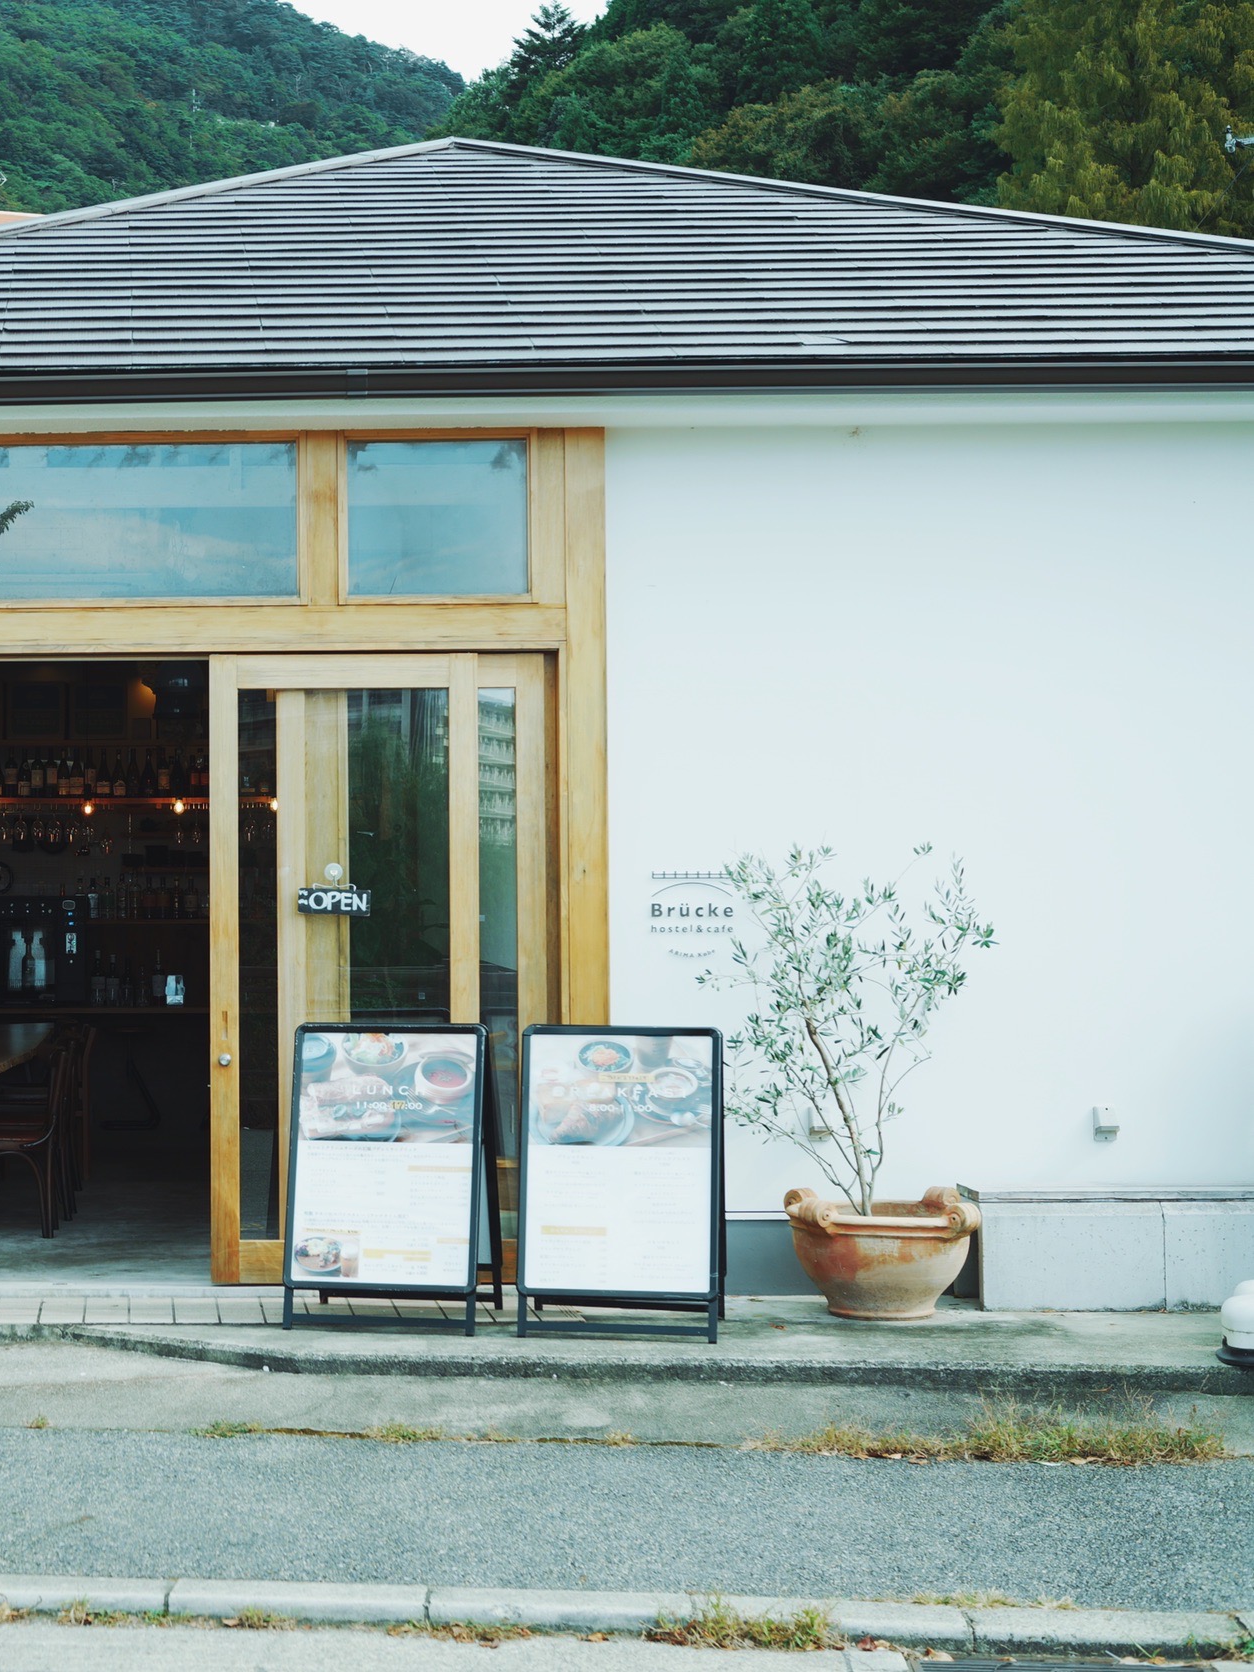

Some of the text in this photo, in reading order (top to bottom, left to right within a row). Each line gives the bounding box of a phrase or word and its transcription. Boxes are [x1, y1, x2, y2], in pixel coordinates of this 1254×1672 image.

[308, 891, 367, 912] OPEN
[651, 903, 734, 918] Brücke
[668, 948, 695, 958] ARIMA
